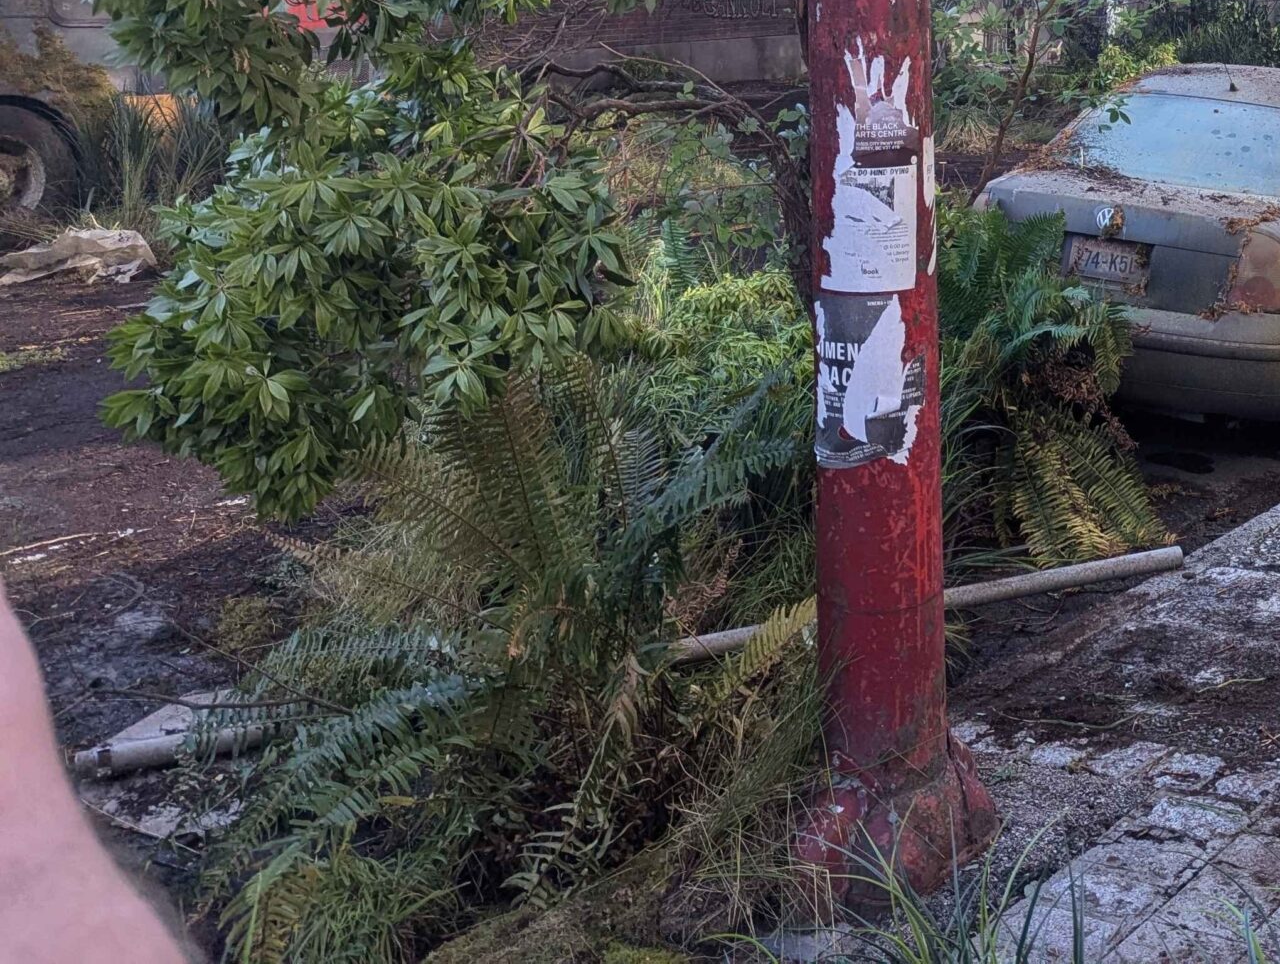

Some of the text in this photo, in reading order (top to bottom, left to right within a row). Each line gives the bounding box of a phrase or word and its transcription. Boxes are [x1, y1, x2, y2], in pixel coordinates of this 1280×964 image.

[856, 122, 898, 131] THE BLACK
[856, 129, 907, 138] ARTS CENTRE
[889, 167, 910, 175] DYING
